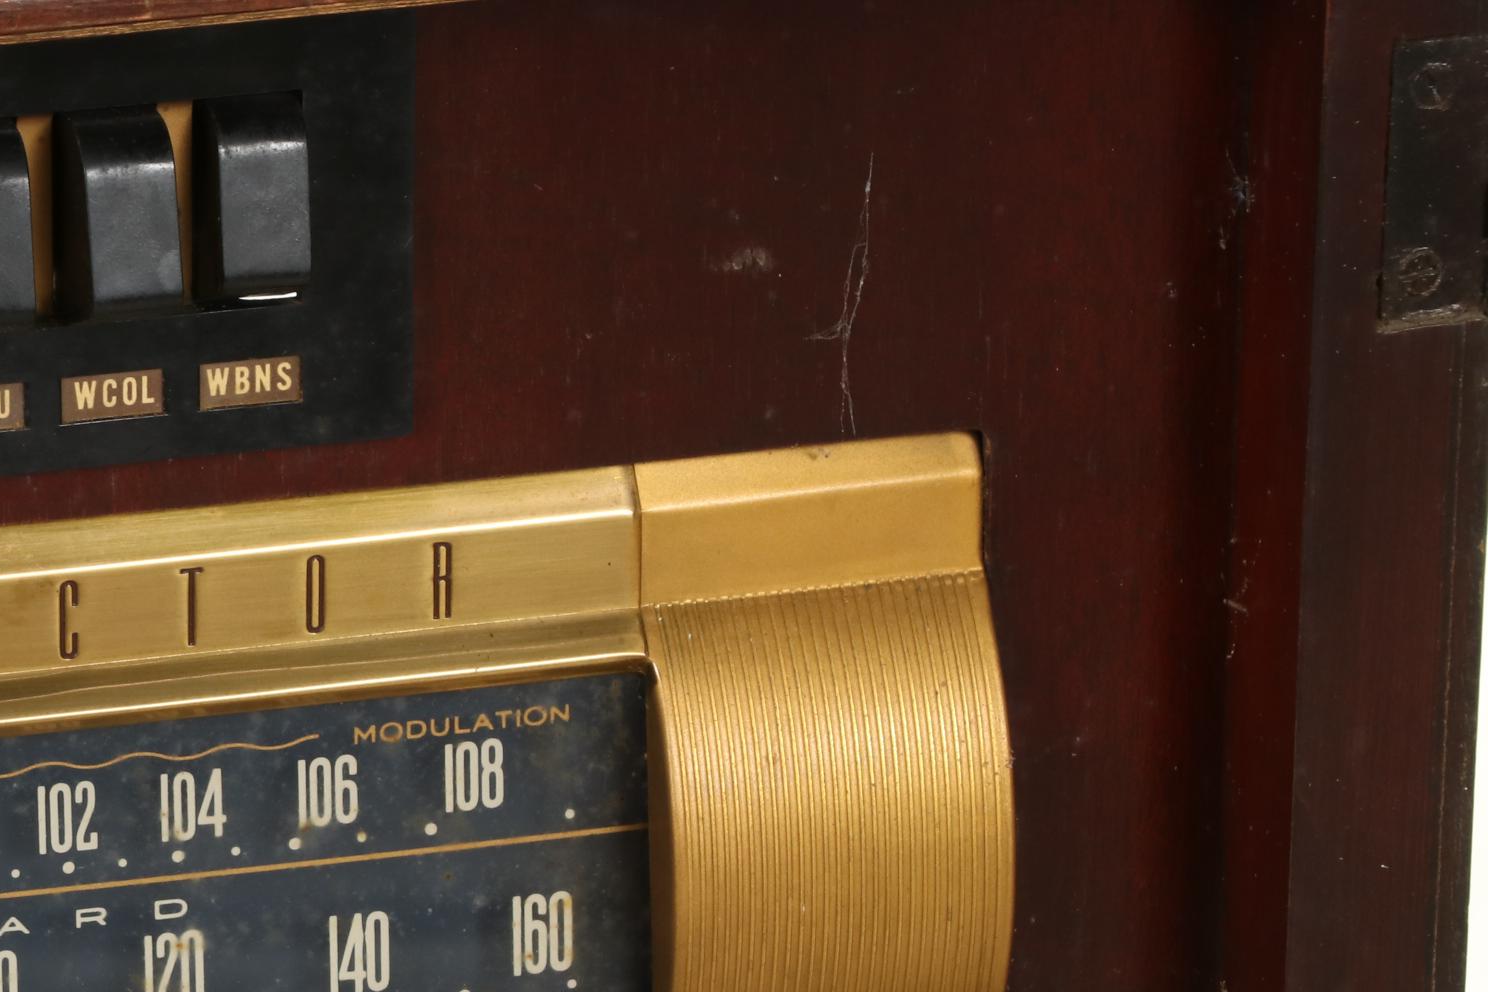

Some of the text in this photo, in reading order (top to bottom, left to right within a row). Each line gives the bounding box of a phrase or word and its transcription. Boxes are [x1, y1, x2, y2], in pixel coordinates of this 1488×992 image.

[74, 374, 155, 410] WCOL
[206, 362, 294, 398] WBNS
[353, 704, 571, 746] MODULATION
[37, 780, 98, 855] 102
[160, 768, 226, 843] 104
[297, 753, 359, 828] 106
[444, 738, 505, 813] 108
[512, 891, 575, 977] 160
